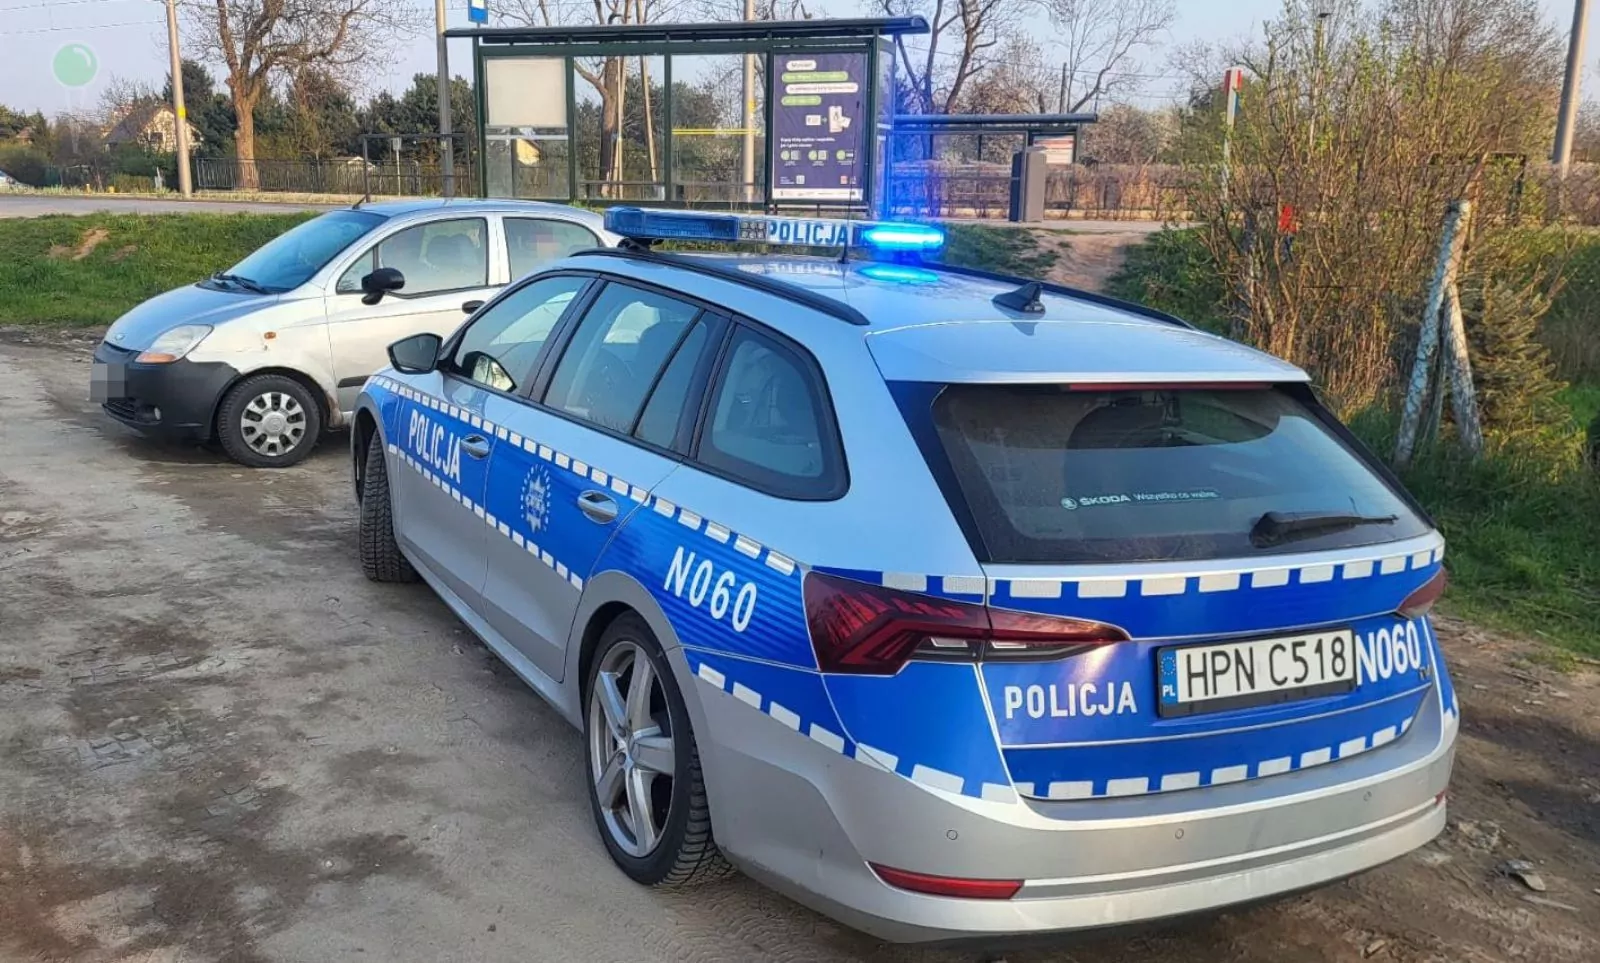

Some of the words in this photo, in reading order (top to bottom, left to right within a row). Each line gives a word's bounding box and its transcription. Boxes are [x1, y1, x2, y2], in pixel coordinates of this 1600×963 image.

[769, 221, 848, 245] POLICJA
[409, 409, 461, 483] POLICJA
[664, 546, 758, 632] N060
[1186, 646, 1255, 698] HPN
[1268, 636, 1347, 685] C518
[1356, 621, 1420, 685] N060
[1005, 681, 1137, 719] POLICJA
[1162, 684, 1176, 697] PL
